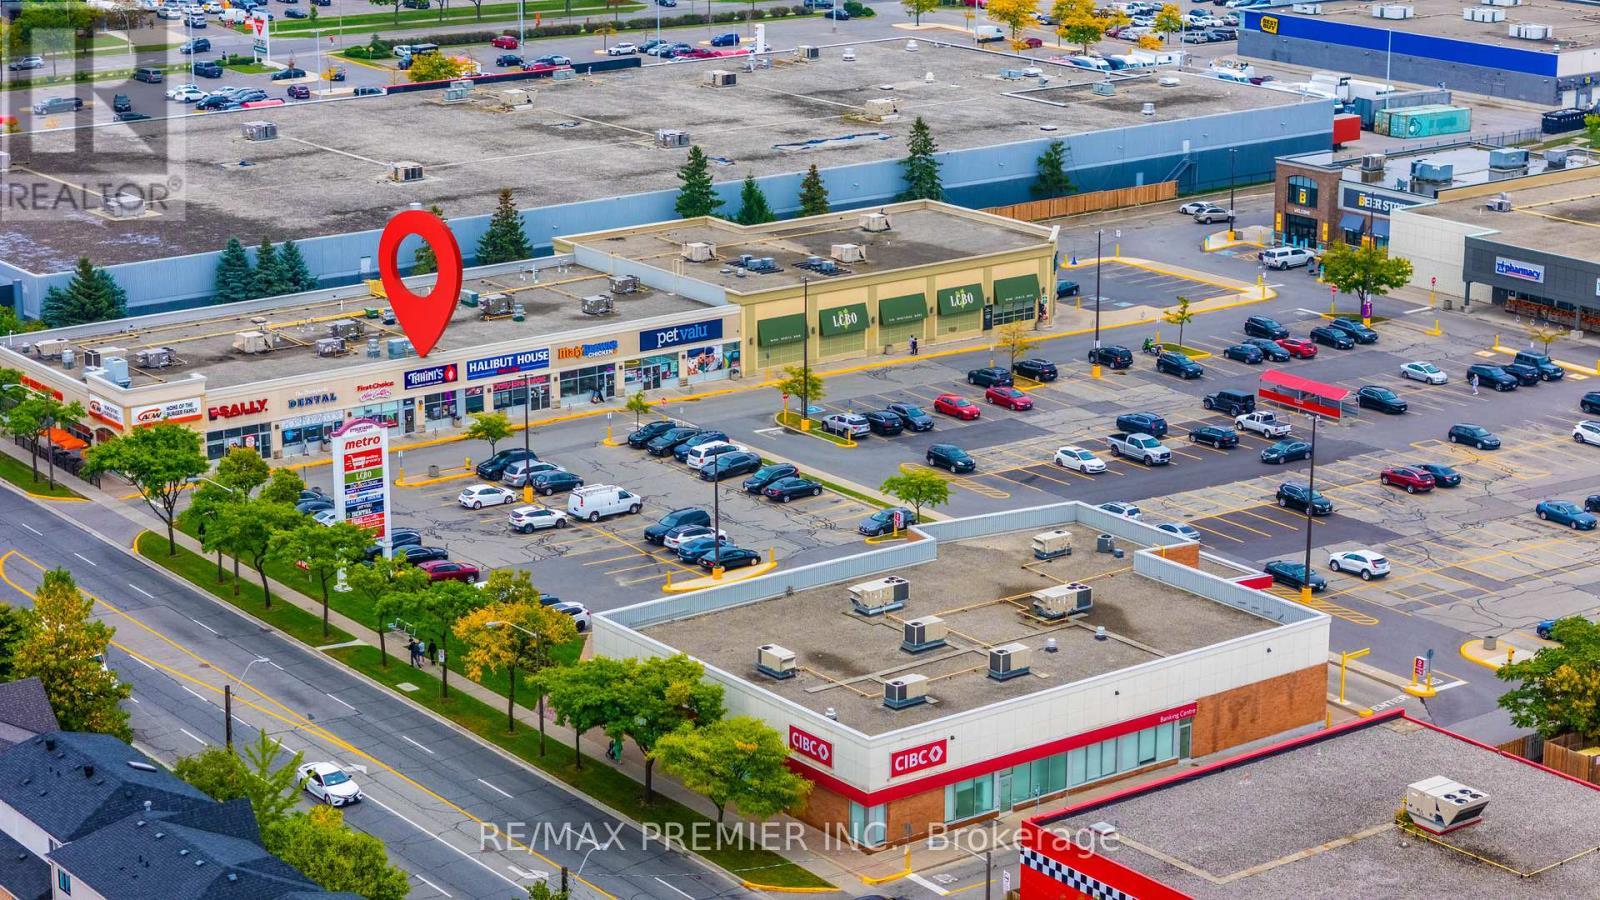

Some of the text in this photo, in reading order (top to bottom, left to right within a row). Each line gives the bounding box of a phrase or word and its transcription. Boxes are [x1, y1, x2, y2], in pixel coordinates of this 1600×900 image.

[1263, 18, 1277, 26] BEST
[1358, 193, 1382, 210] BEER
[1505, 263, 1540, 280] pharmacy
[950, 292, 974, 307] LCBO
[832, 312, 858, 328] LCBO
[656, 324, 708, 348] pet valu
[469, 357, 514, 373] HALIBUT
[517, 350, 549, 365] HOUSE
[288, 393, 337, 409] DENTAL
[345, 435, 380, 450] metro
[356, 470, 372, 481] LCBO
[792, 732, 817, 756] CIBC
[895, 750, 927, 771] CIBC
